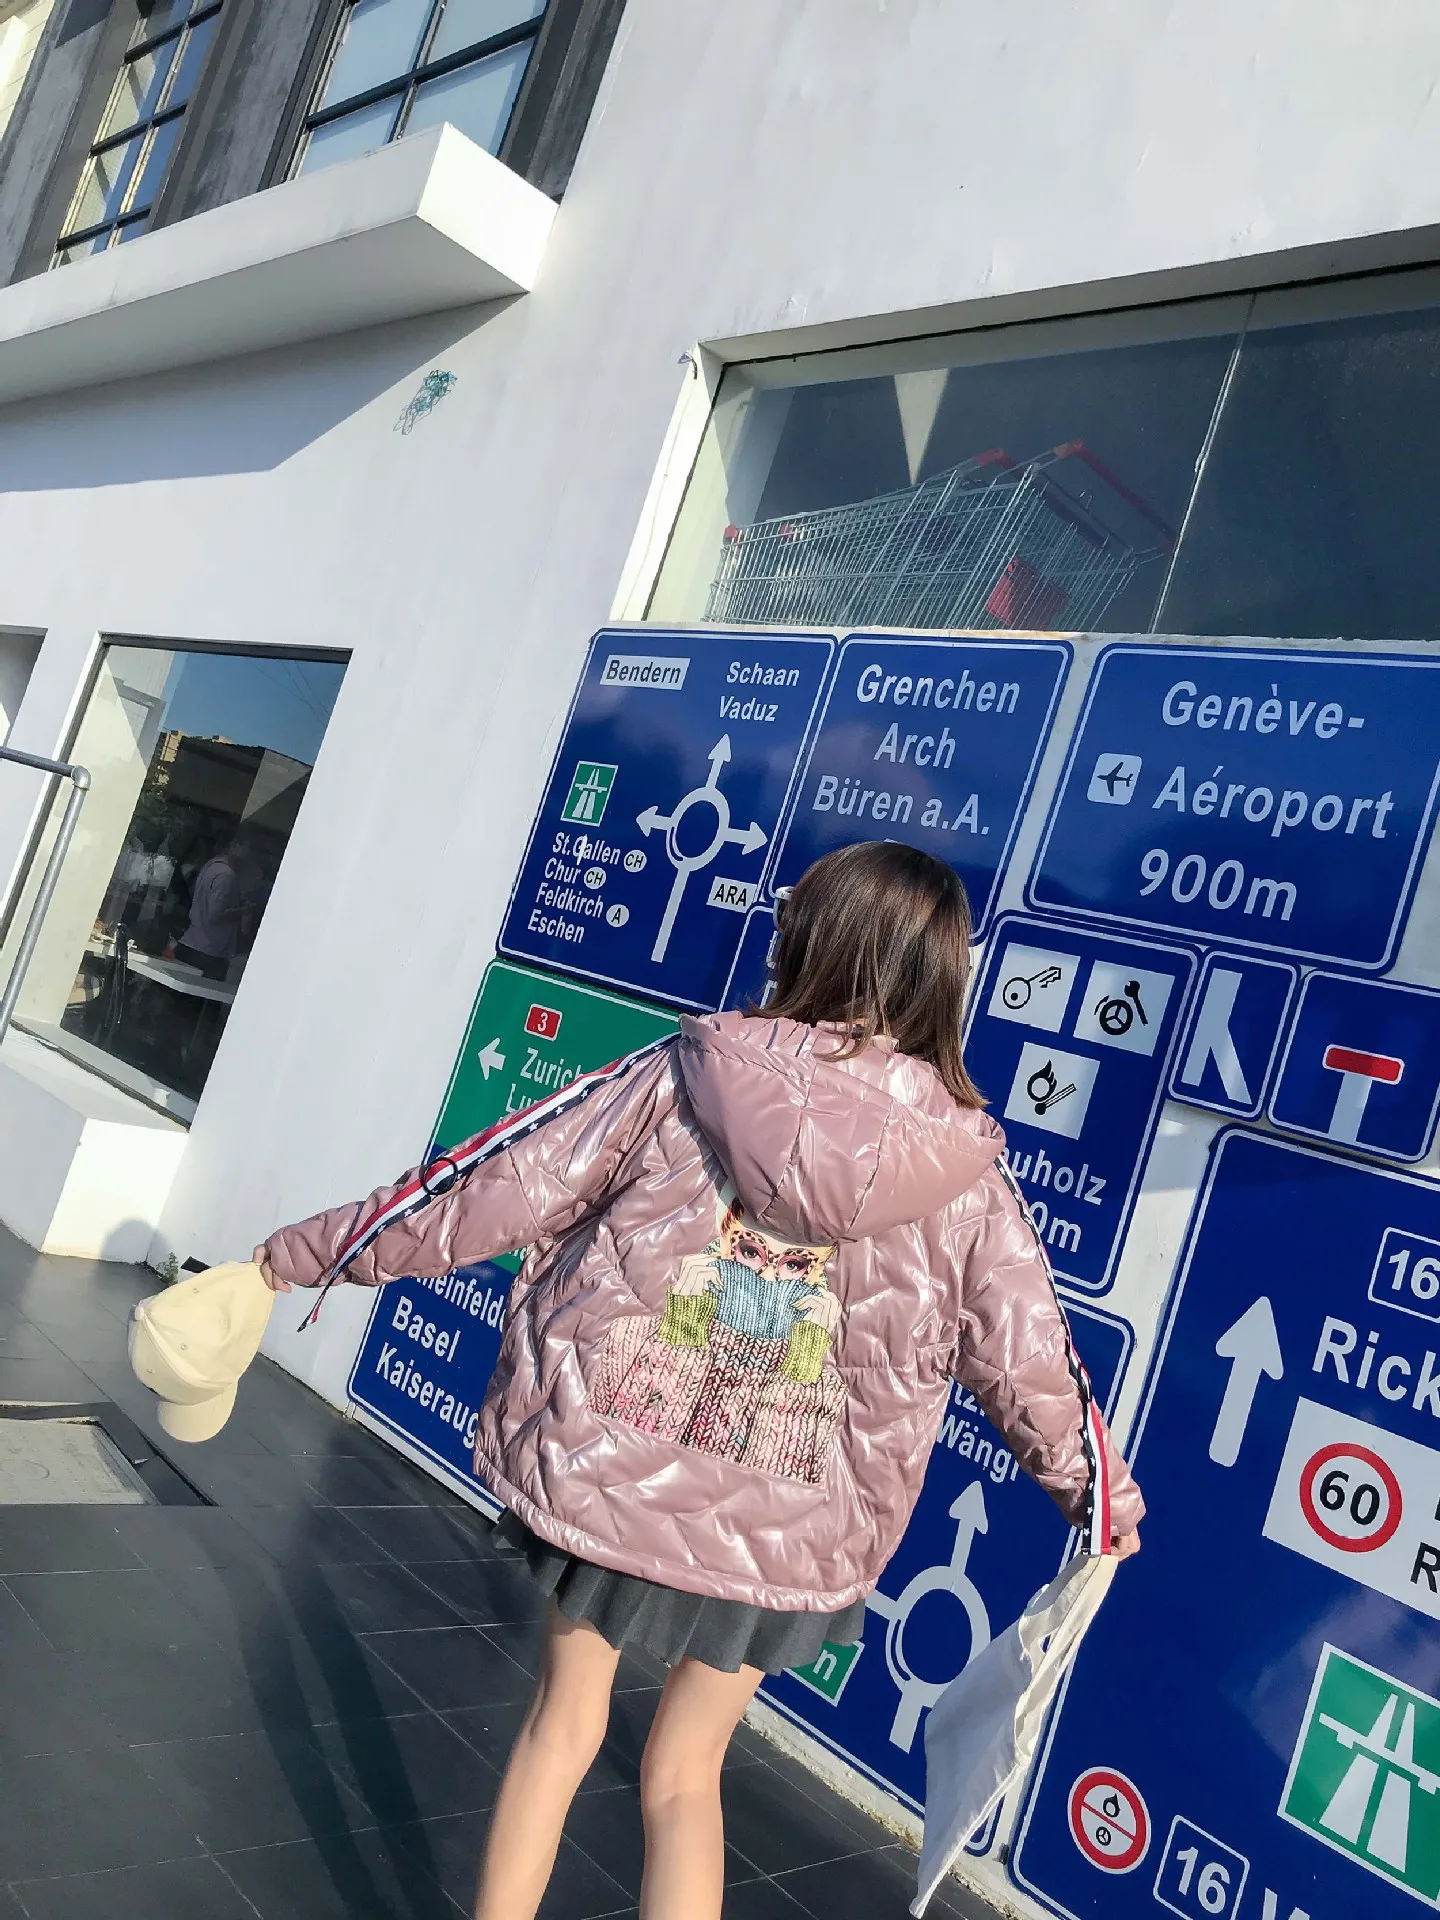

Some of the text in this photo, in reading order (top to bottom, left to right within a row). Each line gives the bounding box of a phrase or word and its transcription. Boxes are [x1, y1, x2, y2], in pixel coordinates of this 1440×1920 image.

[606, 660, 682, 684] Bendern
[726, 661, 800, 687] Schaan
[856, 663, 1021, 714] Grenchen
[719, 696, 779, 722] Vaduz
[1162, 680, 1365, 739] Genève-
[873, 722, 956, 769] Arch
[812, 775, 991, 835] Büren a.A.
[1151, 765, 1394, 839] Aéroport
[545, 857, 604, 885] Chur CH
[625, 853, 644, 869] CH
[1140, 849, 1297, 921] 900m
[535, 882, 622, 924] Feldkirch A
[712, 883, 748, 906] ARA
[527, 908, 585, 943] Eschen
[536, 1012, 549, 1032] 3
[1004, 1147, 1107, 1206] uholz
[1387, 1249, 1440, 1300] 16
[391, 1295, 461, 1363] Basel
[375, 1342, 479, 1449] Kaiseraug
[1319, 1470, 1380, 1525] 60
[1176, 1846, 1231, 1914] 16
